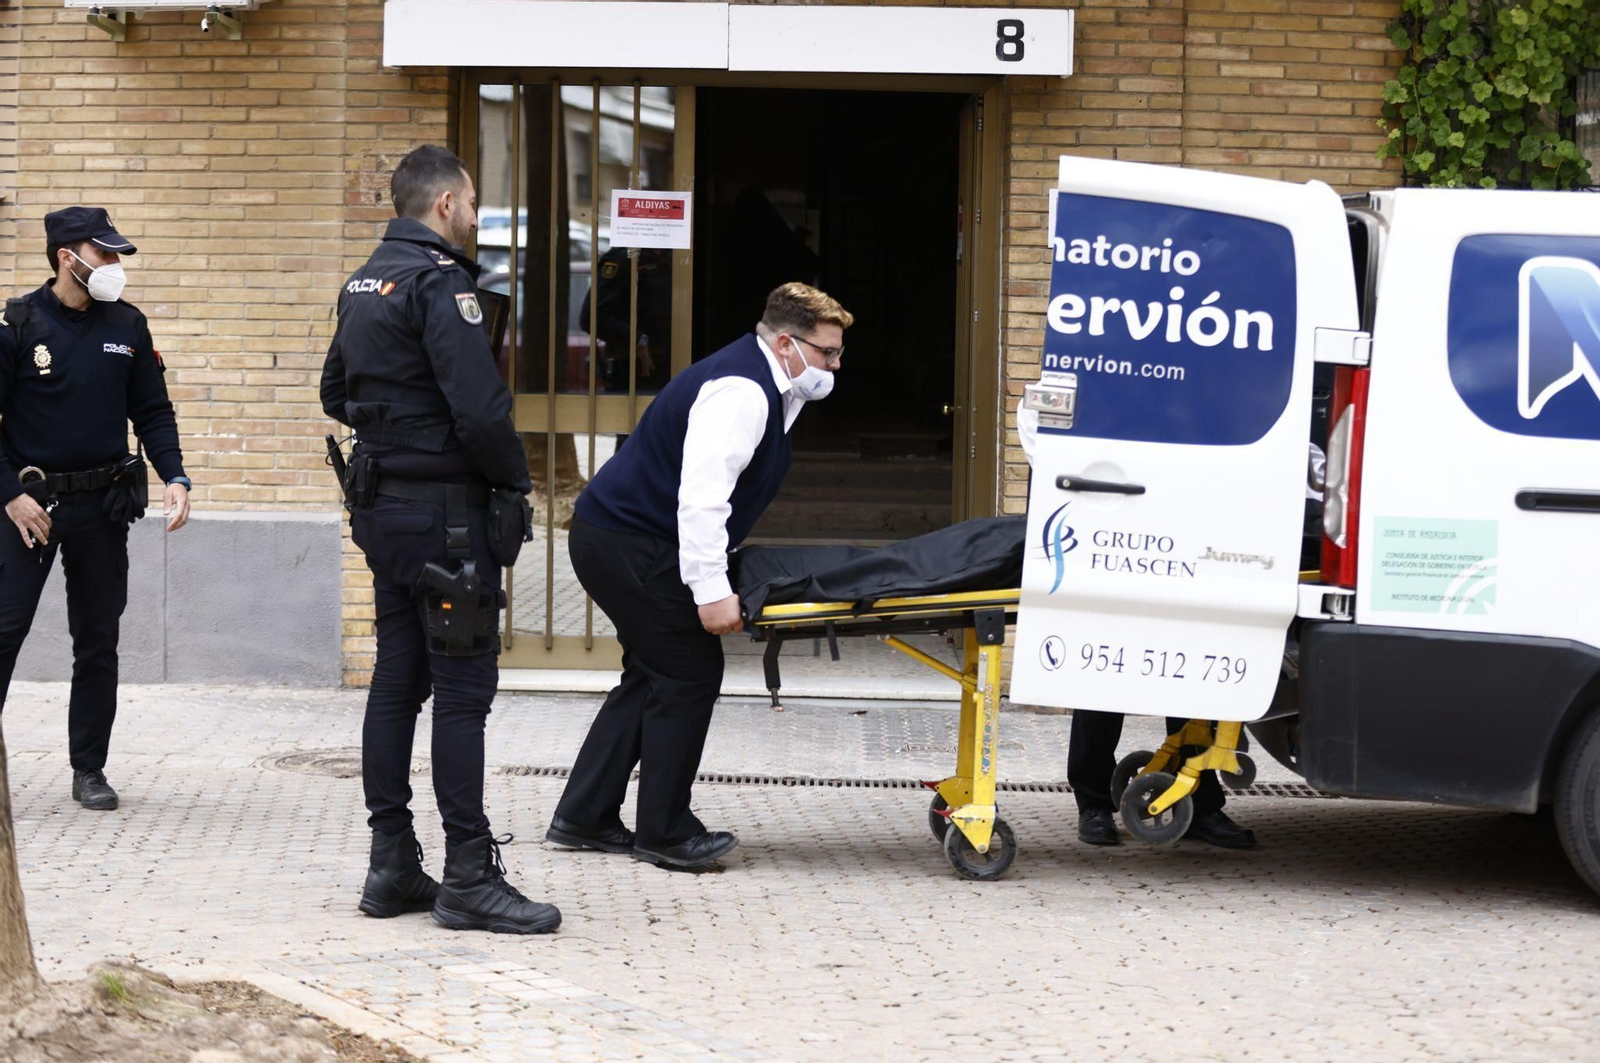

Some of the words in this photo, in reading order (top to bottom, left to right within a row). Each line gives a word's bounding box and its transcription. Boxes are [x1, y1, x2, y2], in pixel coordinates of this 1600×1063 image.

[995, 19, 1025, 62] 8
[634, 200, 670, 210] ALDIYAS
[1053, 235, 1201, 276] natorio
[1047, 286, 1274, 351] ervión
[1045, 353, 1186, 381] nervion.com
[1092, 530, 1175, 554] GRUPO
[1091, 553, 1197, 578] FUASCEN
[1080, 643, 1125, 674] 954
[1140, 649, 1187, 679] 512
[1201, 655, 1248, 684] 739
